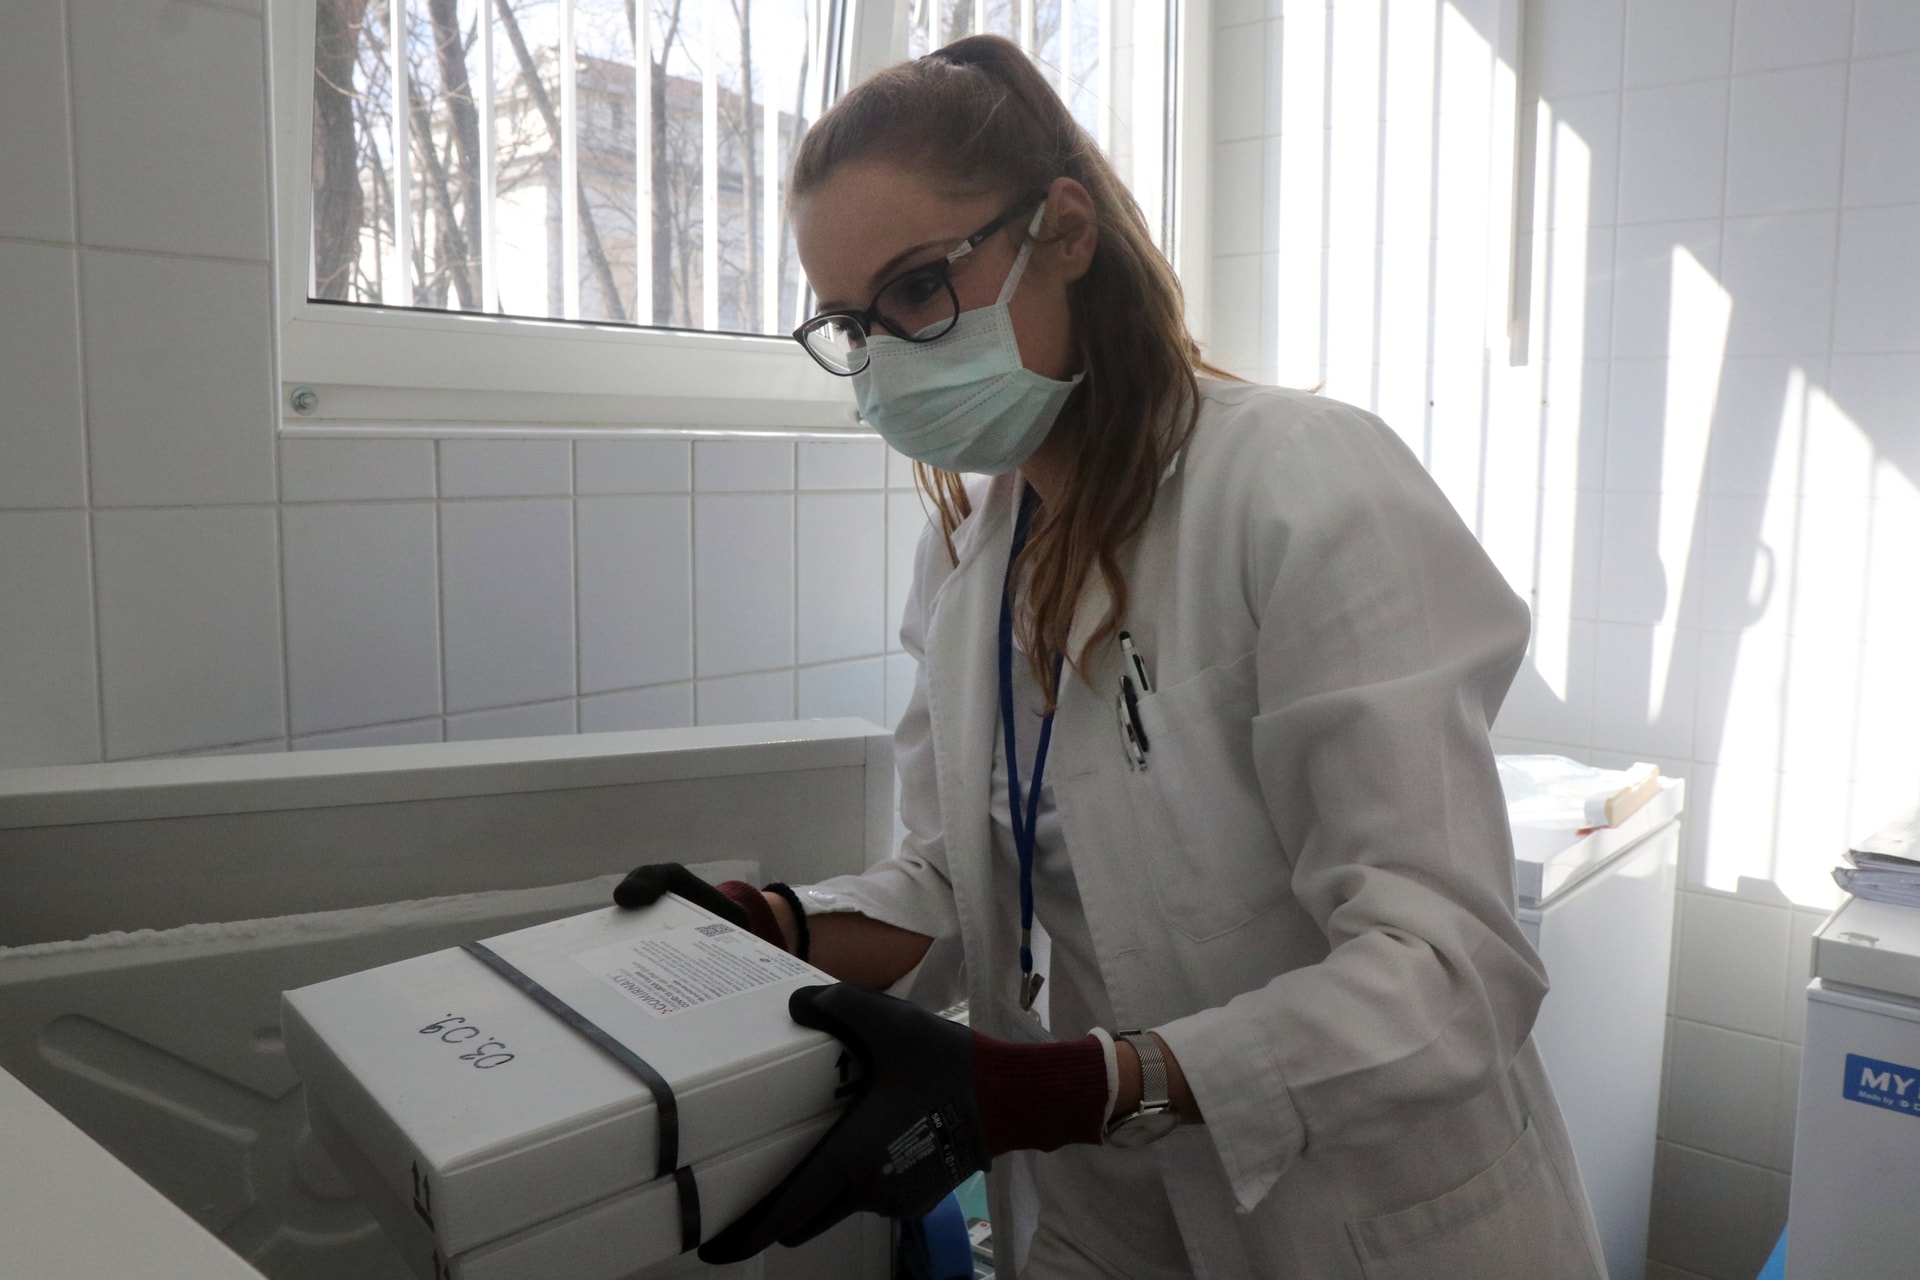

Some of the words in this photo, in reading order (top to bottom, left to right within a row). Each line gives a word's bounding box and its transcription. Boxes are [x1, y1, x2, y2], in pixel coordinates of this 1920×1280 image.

[610, 975, 667, 1010] COMIRNATY
[1861, 1067, 1920, 1099] MY
[1859, 1090, 1881, 1101] Made
[1882, 1097, 1894, 1106] by
[931, 1112, 943, 1128] 580
